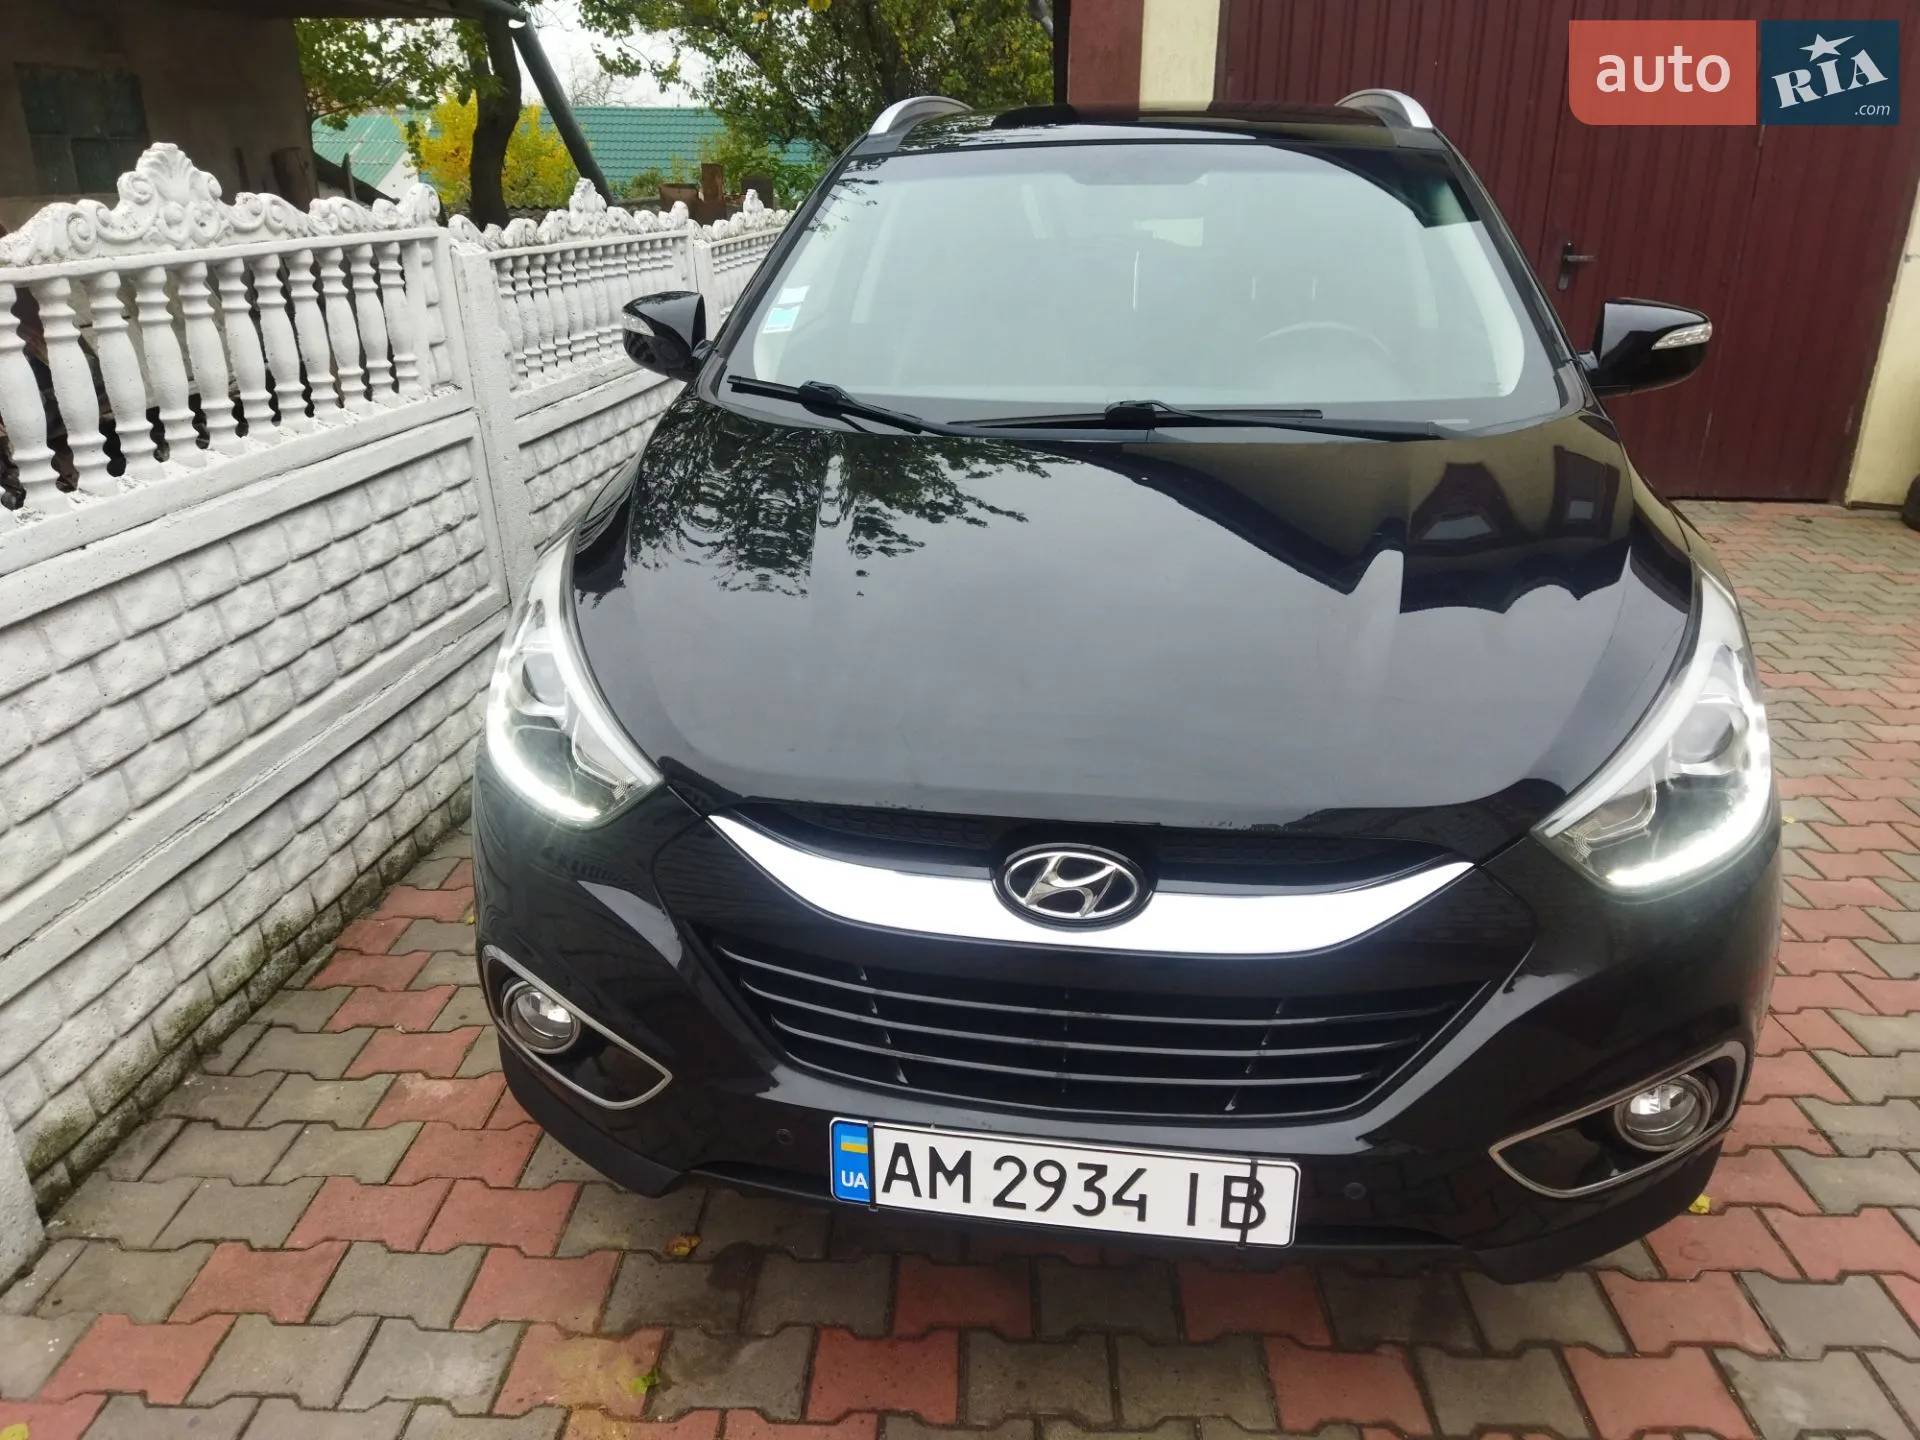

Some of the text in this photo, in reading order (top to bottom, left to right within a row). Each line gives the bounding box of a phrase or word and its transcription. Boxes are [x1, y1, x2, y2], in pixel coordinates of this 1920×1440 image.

[841, 1170, 868, 1189] UA
[881, 1141, 1266, 1230] AM 2934 IB
